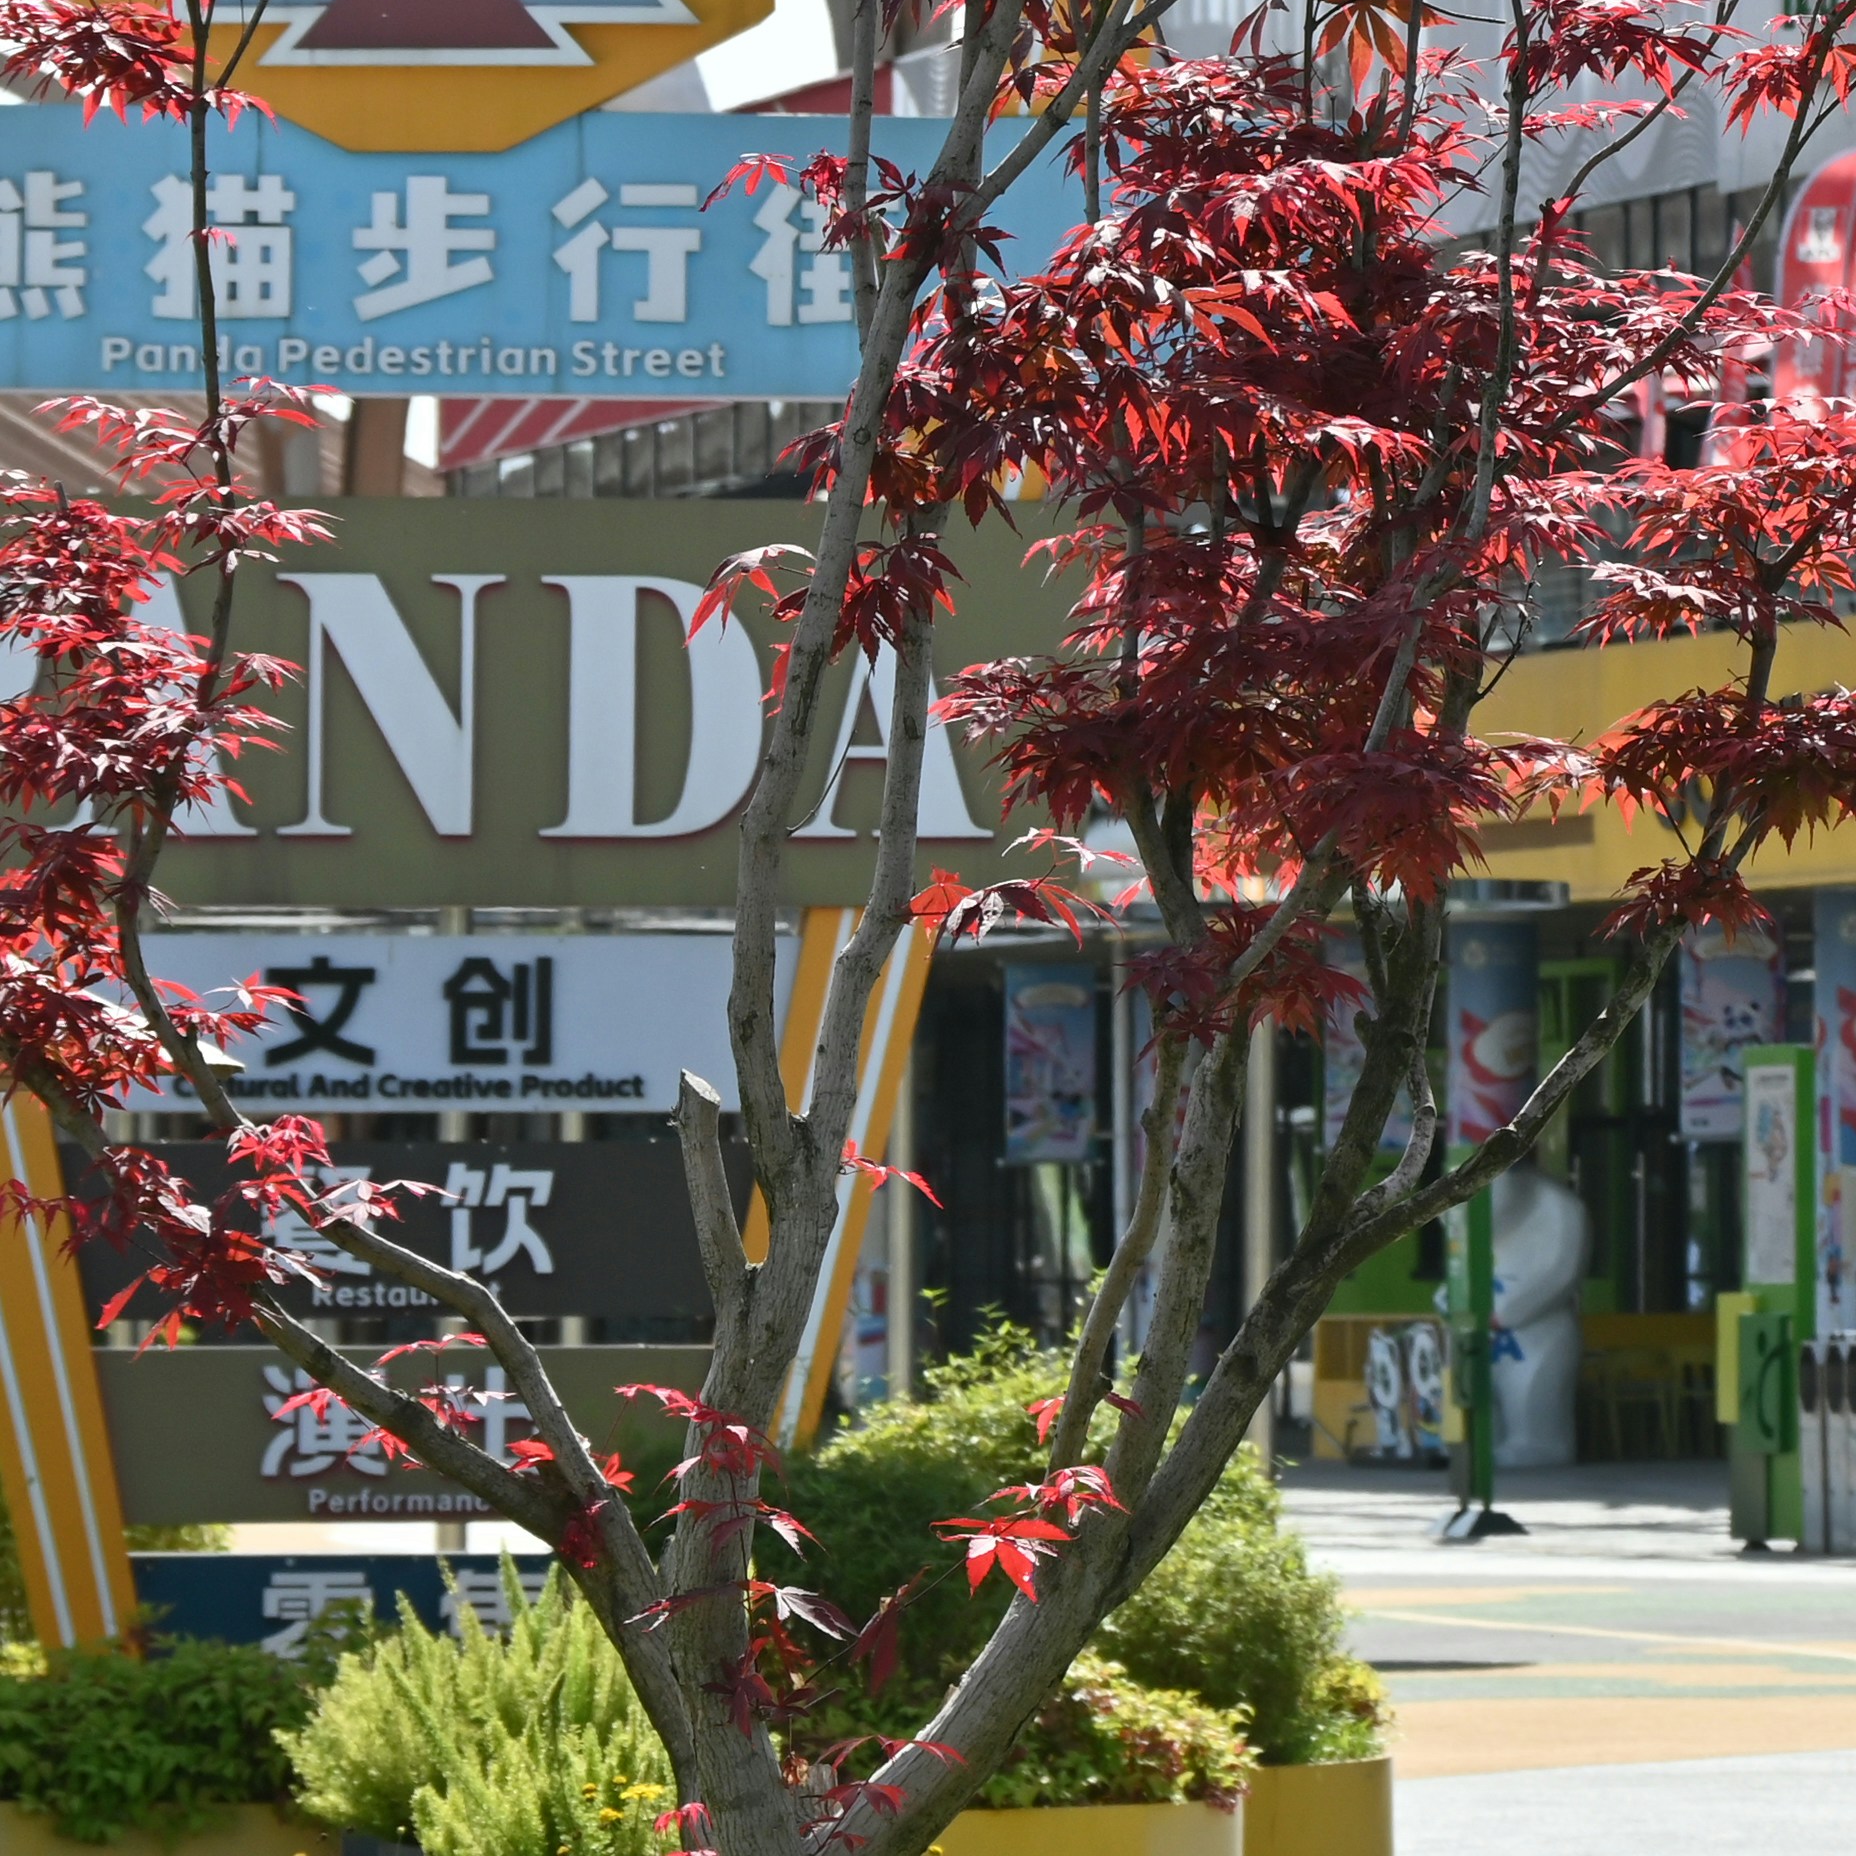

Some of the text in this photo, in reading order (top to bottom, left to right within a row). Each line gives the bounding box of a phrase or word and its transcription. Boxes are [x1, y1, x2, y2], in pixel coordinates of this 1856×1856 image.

[278, 336, 556, 376] Pedestrian
[571, 340, 726, 377] Street
[0, 572, 995, 836] NDA
[264, 956, 554, 1067] 文创
[172, 1072, 644, 1100] Ctural And Creative Product
[311, 1281, 503, 1308] Restaut
[307, 1487, 491, 1515] Performanc
